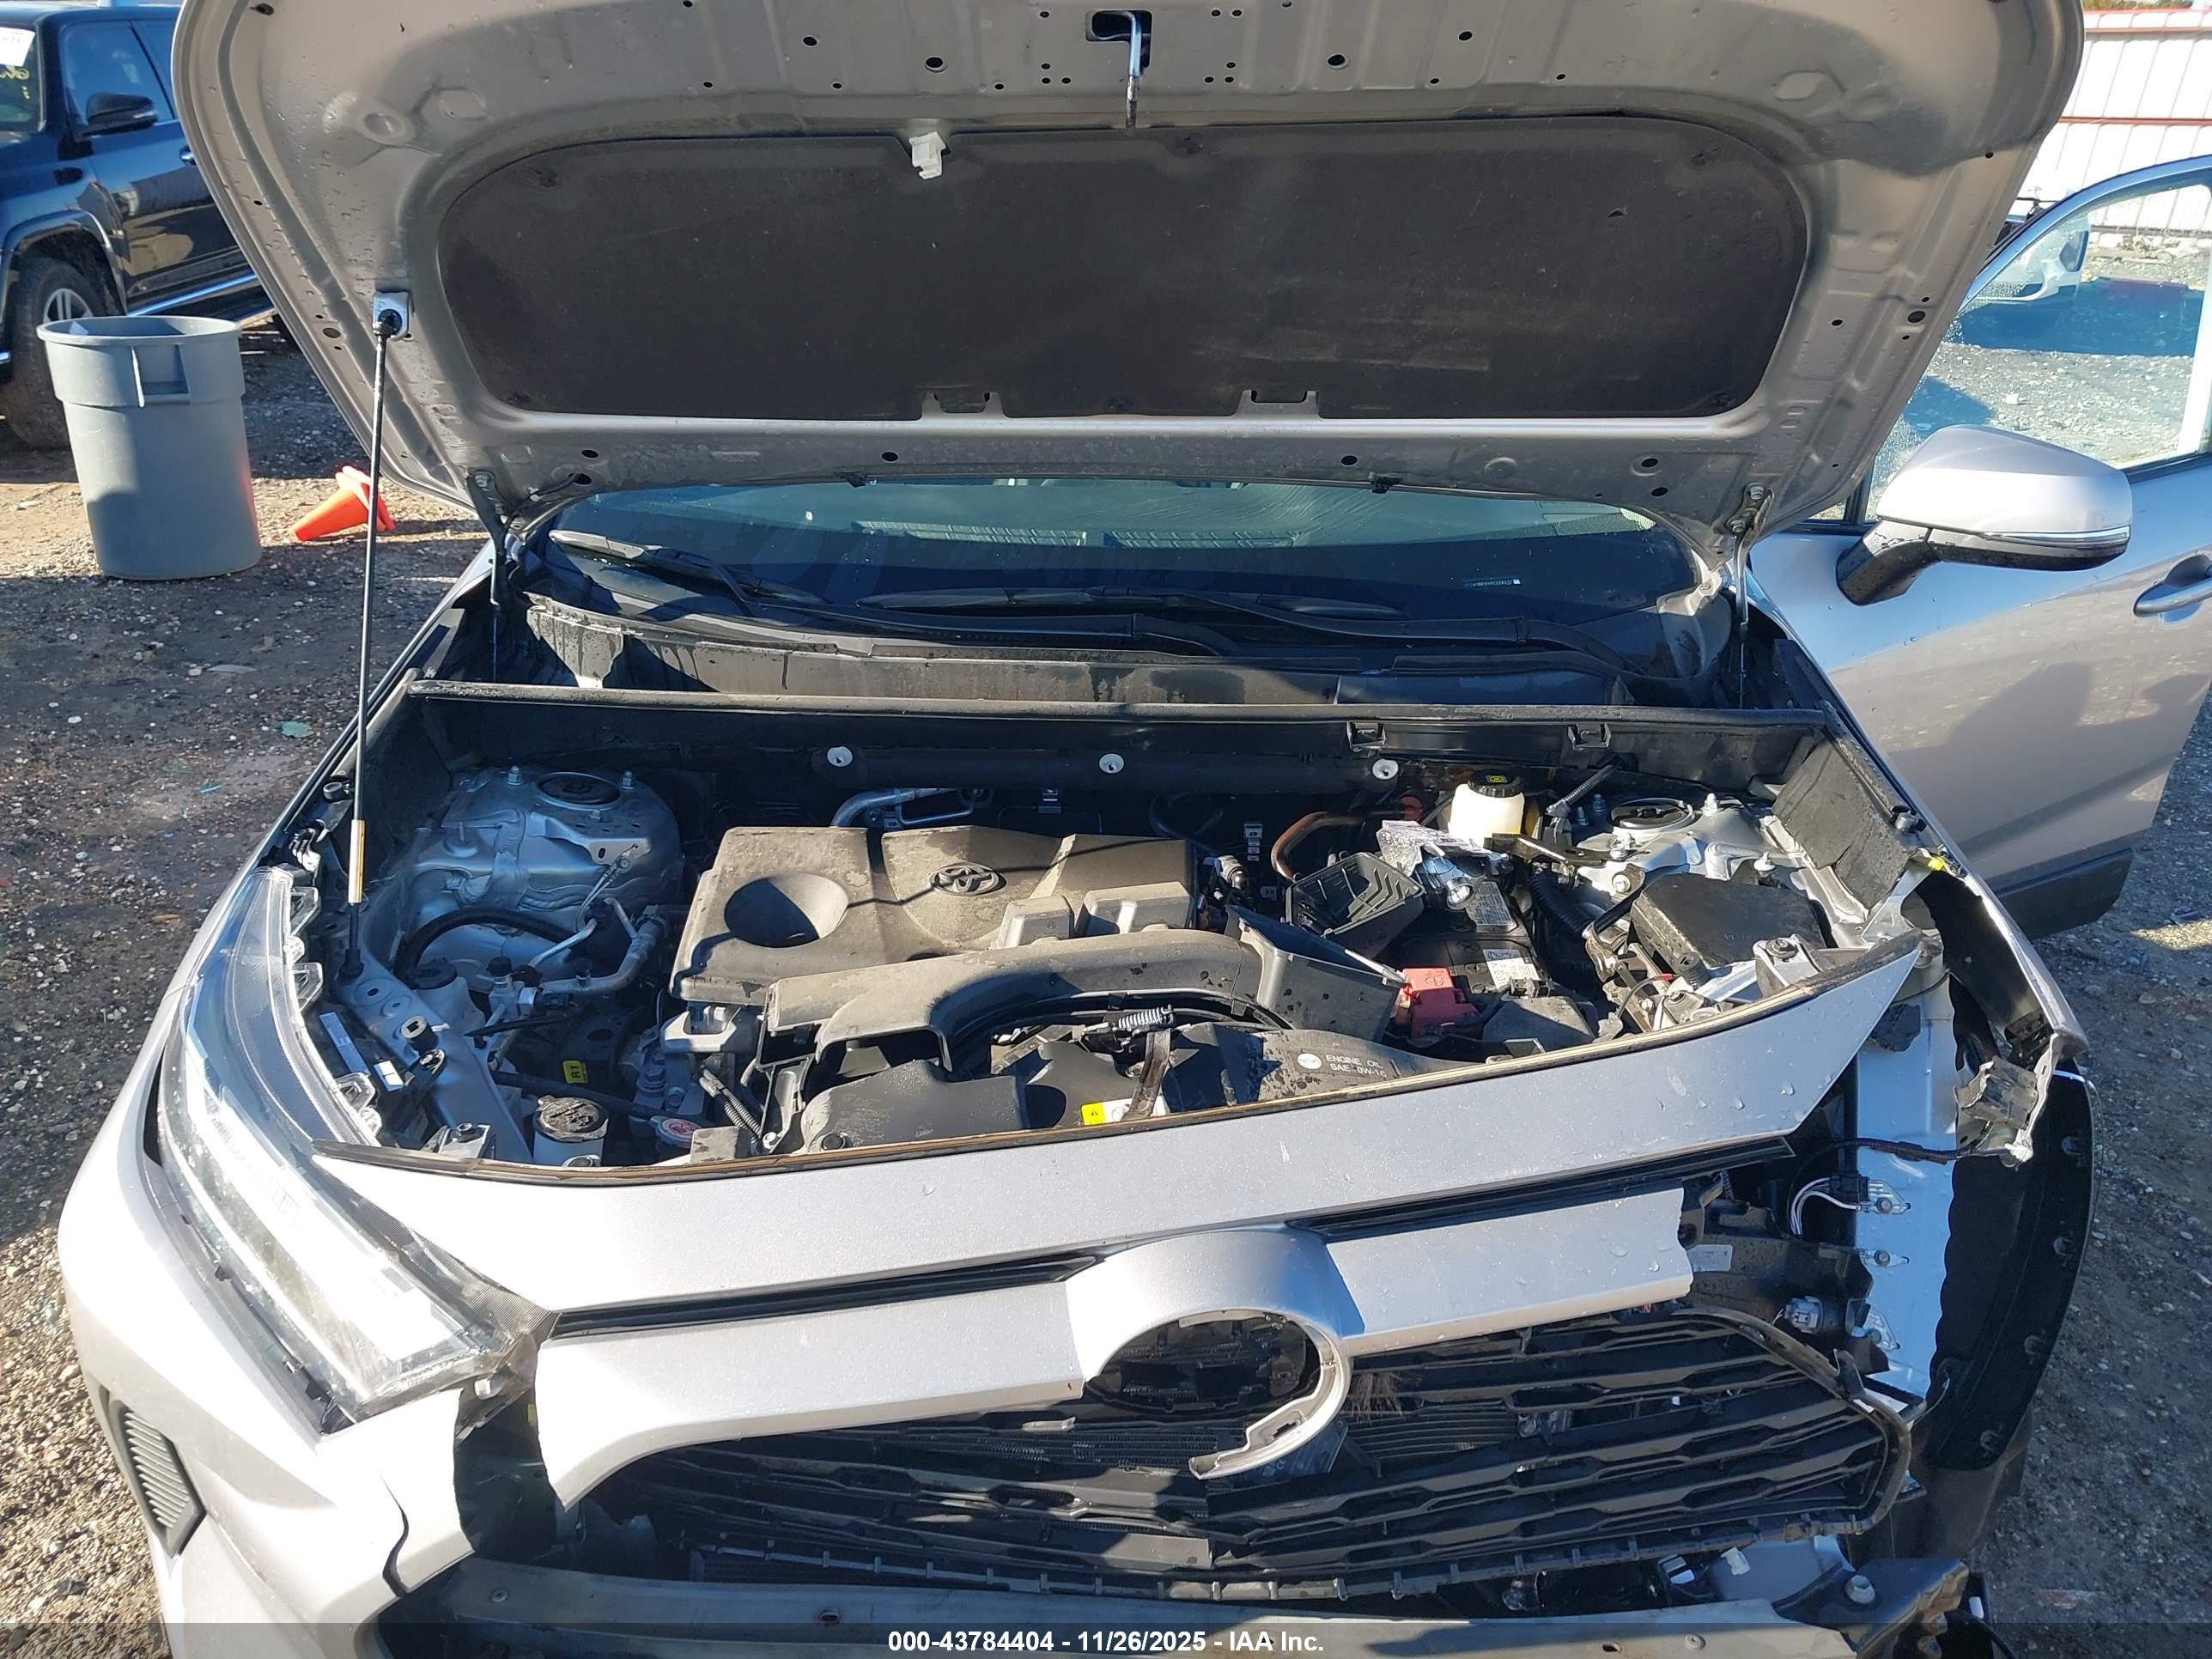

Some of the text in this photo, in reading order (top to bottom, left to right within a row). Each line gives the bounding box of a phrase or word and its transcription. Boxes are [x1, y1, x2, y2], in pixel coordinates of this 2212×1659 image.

[1325, 1054, 1384, 1069] ENGINE OIL
[1330, 1063, 1352, 1073] SAE
[569, 1066, 581, 1079] R1
